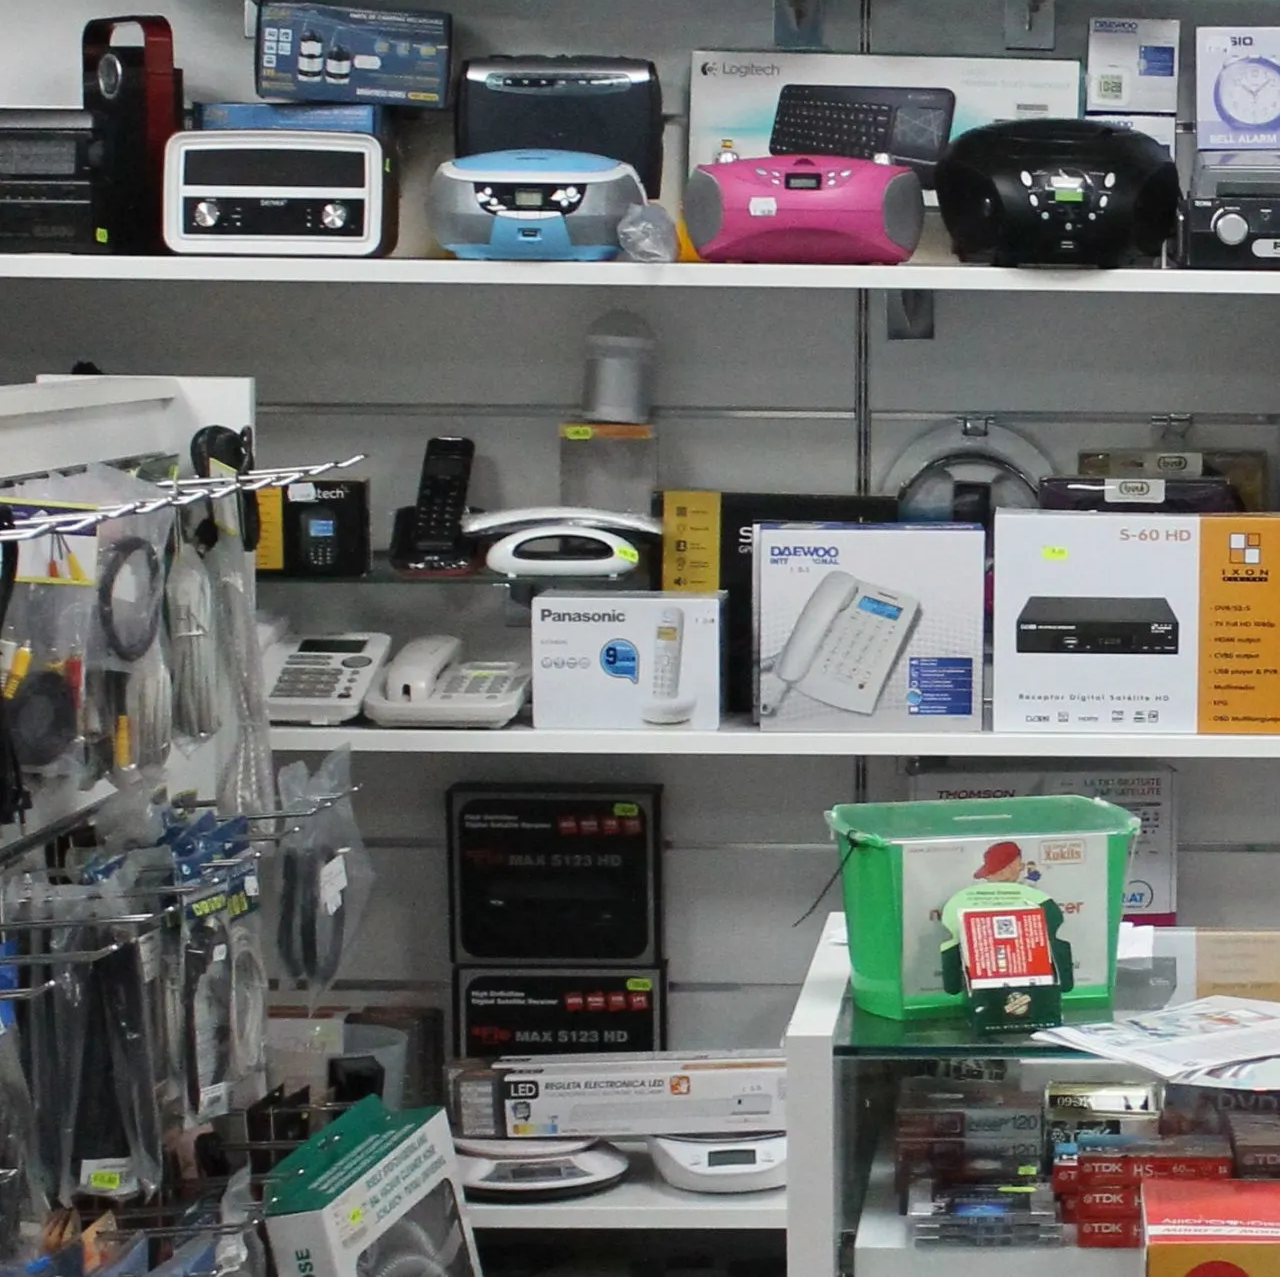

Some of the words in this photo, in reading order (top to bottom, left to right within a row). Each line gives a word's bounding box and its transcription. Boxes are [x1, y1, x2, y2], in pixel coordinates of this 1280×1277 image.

[722, 61, 780, 78] Logitech
[1209, 133, 1236, 144] BELL
[1238, 133, 1278, 144] ALARM
[1119, 528, 1160, 541] S-60
[1165, 529, 1192, 542] HD
[770, 546, 840, 557] DAEWOO
[1222, 568, 1269, 577] IXON
[540, 608, 627, 623] Panasonic
[605, 646, 617, 665] 9
[1018, 694, 1065, 702] Receptor
[1069, 694, 1106, 703] Digital
[1154, 694, 1170, 702] HD
[937, 789, 1017, 799] THOMSON
[551, 853, 593, 867] S123
[597, 853, 623, 867] HD
[515, 1029, 552, 1043] MAX
[557, 1029, 600, 1043] S123
[603, 1030, 629, 1043] HD
[510, 1083, 536, 1097] LED
[544, 1081, 582, 1091] REGLETA
[584, 1079, 647, 1090] ELECTRONICA
[648, 1078, 664, 1088] LED
[1012, 1115, 1038, 1129] 120
[1092, 1162, 1123, 1173] TDK
[1092, 1193, 1124, 1204] TDK
[1092, 1223, 1123, 1234] TDK
